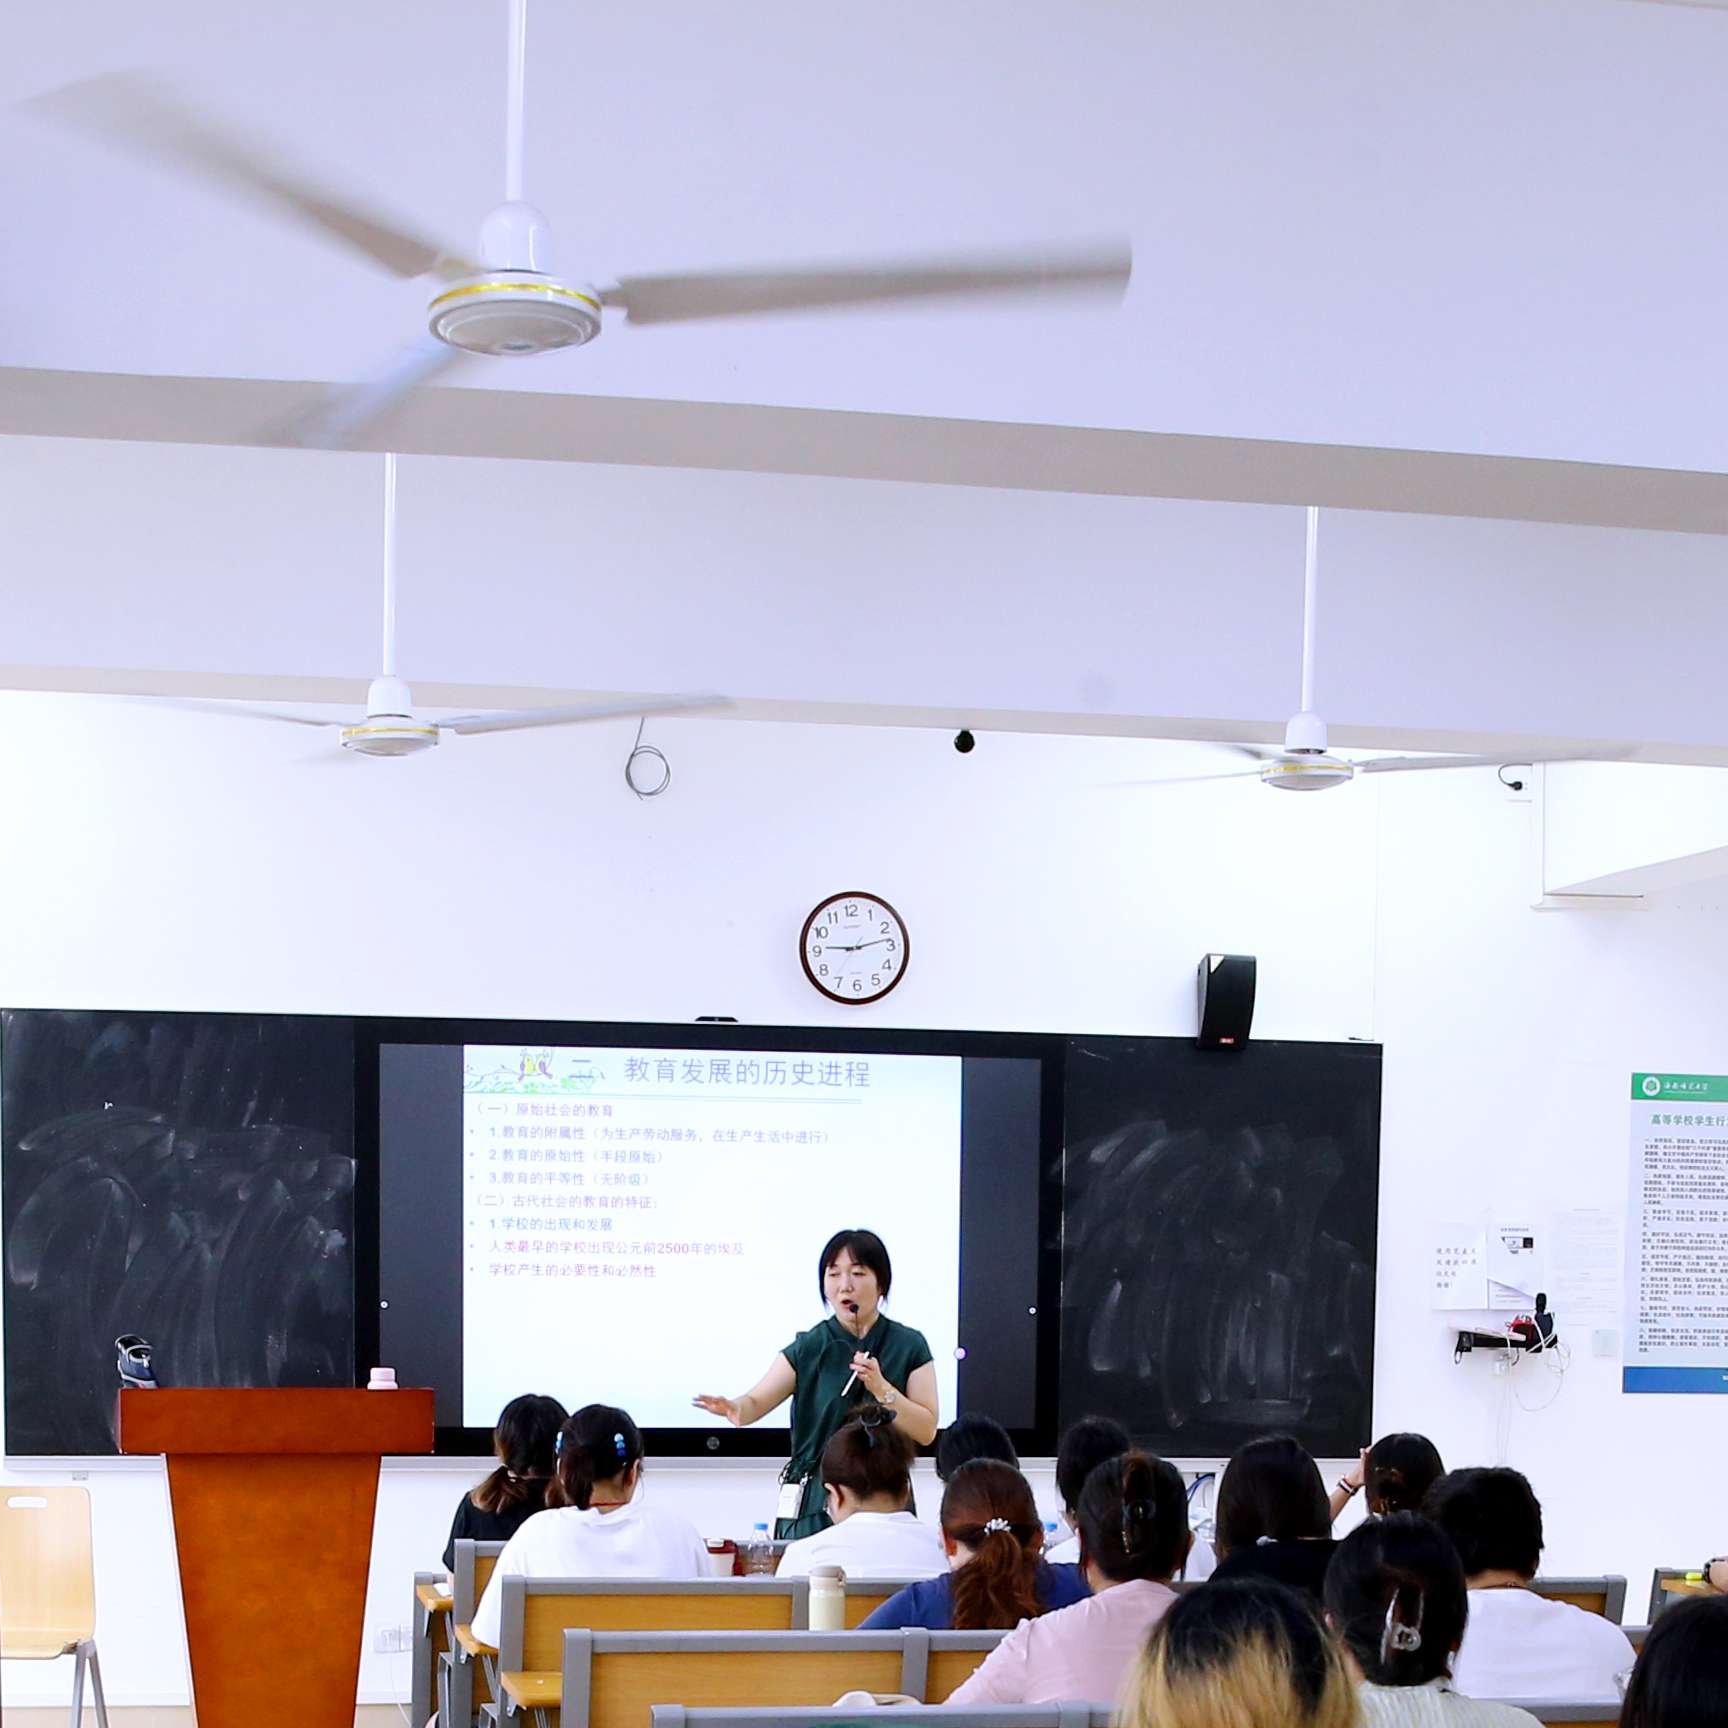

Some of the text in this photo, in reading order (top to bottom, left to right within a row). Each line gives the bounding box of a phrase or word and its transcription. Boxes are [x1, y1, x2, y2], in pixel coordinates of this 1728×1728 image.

[844, 904, 859, 917] 12
[827, 911, 839, 924] 11
[814, 926, 829, 939] 10
[879, 921, 890, 934] 2
[812, 945, 822, 957] 9
[886, 938, 896, 952] 3
[819, 964, 829, 976] 8
[881, 958, 892, 971] 4
[834, 976, 844, 989] 7
[852, 979, 862, 992] 6
[871, 973, 881, 986] 5
[624, 1055, 871, 1088] 教育发展的历史进程
